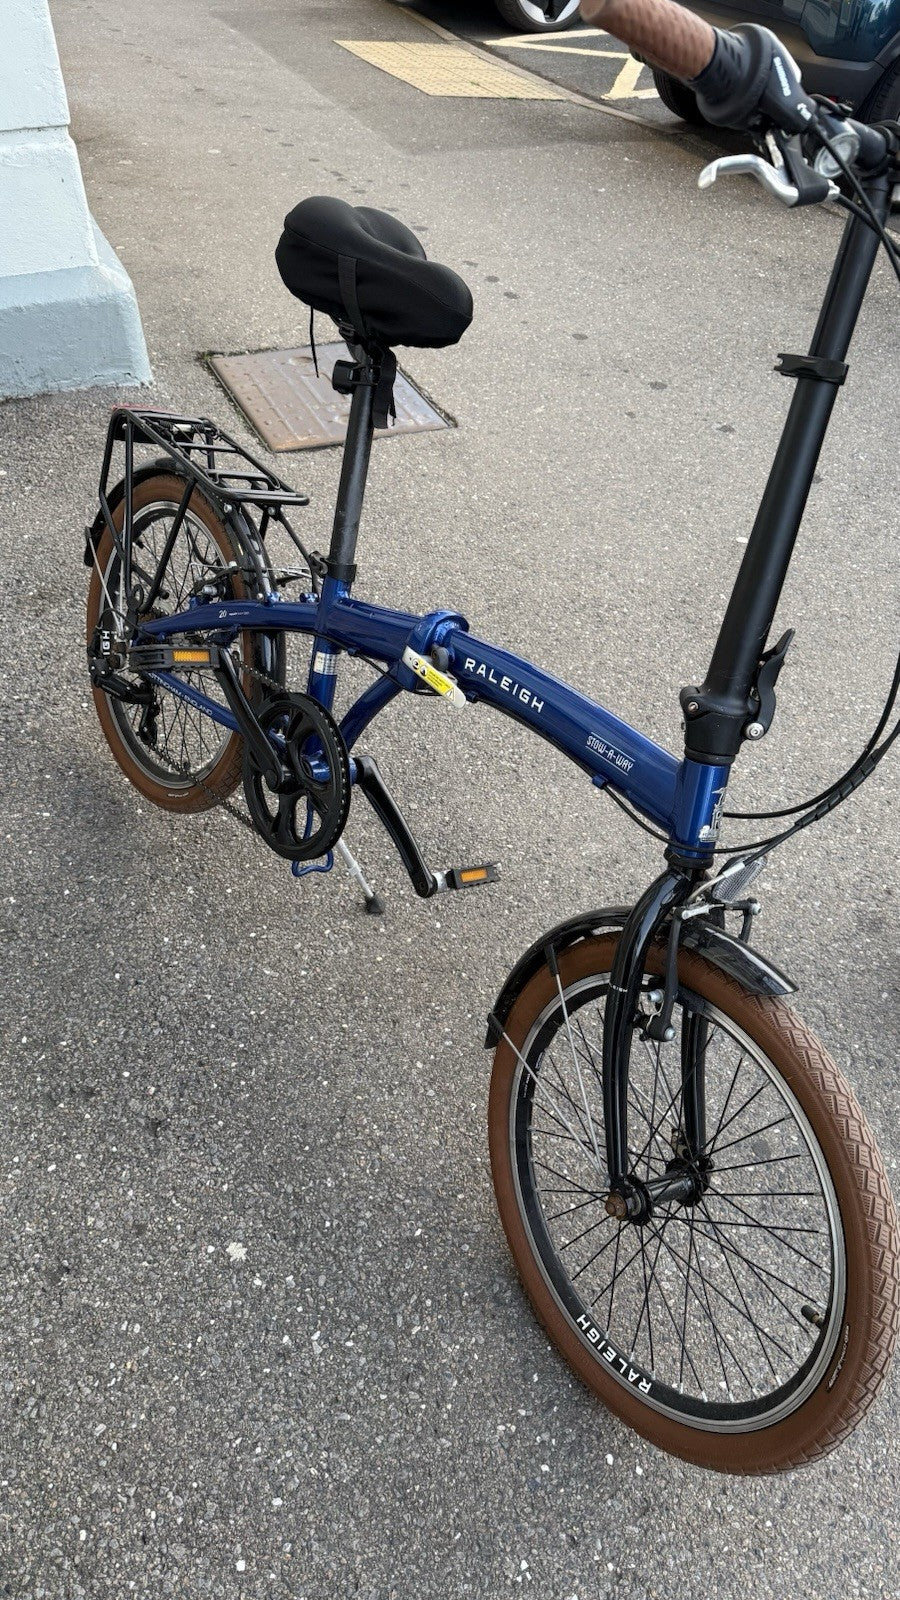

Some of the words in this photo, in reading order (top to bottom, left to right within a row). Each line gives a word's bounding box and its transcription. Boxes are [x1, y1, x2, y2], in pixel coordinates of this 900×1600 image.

[102, 630, 111, 655] IGH
[464, 657, 545, 714] RALEIGH
[183, 694, 213, 716] ENGLAND
[586, 735, 634, 773] STOW-A-WAY
[576, 1314, 652, 1394] RALEIGH
